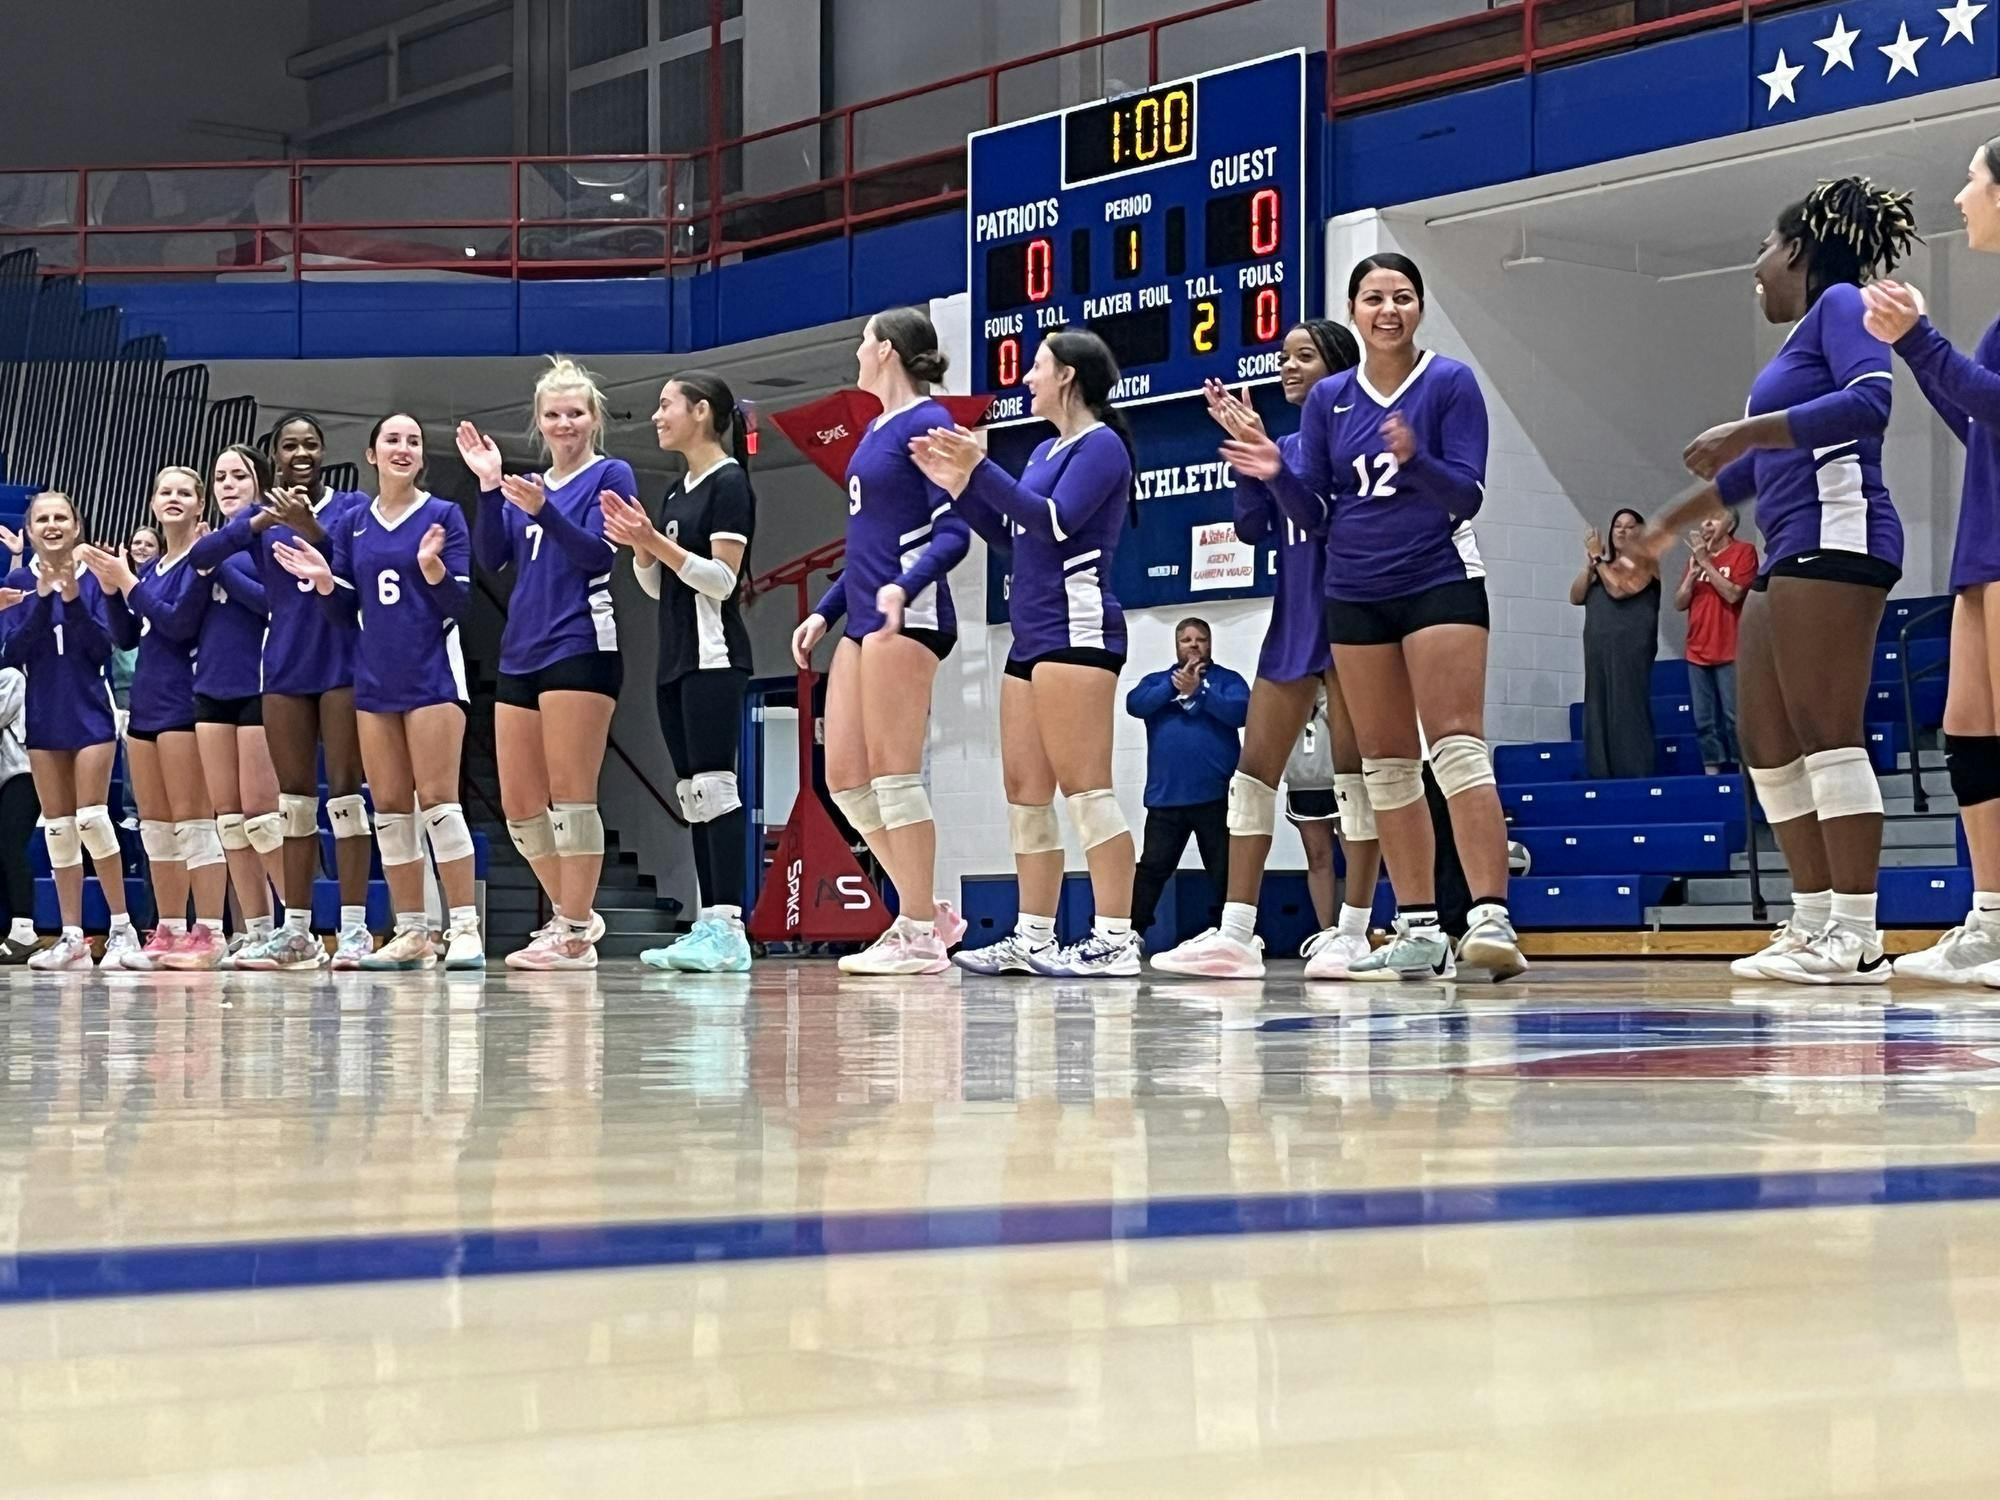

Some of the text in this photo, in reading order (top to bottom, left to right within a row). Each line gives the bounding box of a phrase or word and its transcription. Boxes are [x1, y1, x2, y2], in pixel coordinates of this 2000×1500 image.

[1113, 90, 1188, 163] 1:00
[1210, 147, 1277, 190] GUEST
[976, 198, 1059, 242] PATRIOTS
[1105, 193, 1152, 222] PERIOD
[1252, 189, 1278, 255] 0
[1027, 239, 1050, 302] 0
[1130, 230, 1137, 271] 1
[1185, 275, 1222, 300] T.O.L.
[1239, 261, 1284, 290] FOULS
[1036, 304, 1069, 329] T.O.L.
[1083, 285, 1172, 320] PLAYER FOUL
[1256, 289, 1278, 342] 0
[984, 313, 1023, 339] FOULS
[1193, 302, 1215, 351] 2
[999, 339, 1017, 387] 0
[1238, 351, 1281, 378] SCORE
[1352, 452, 1399, 497] 12
[849, 475, 861, 515] 9
[525, 523, 544, 561] 7
[377, 568, 401, 606] 6
[53, 623, 64, 656] 1
[786, 859, 802, 931] SPIKE
